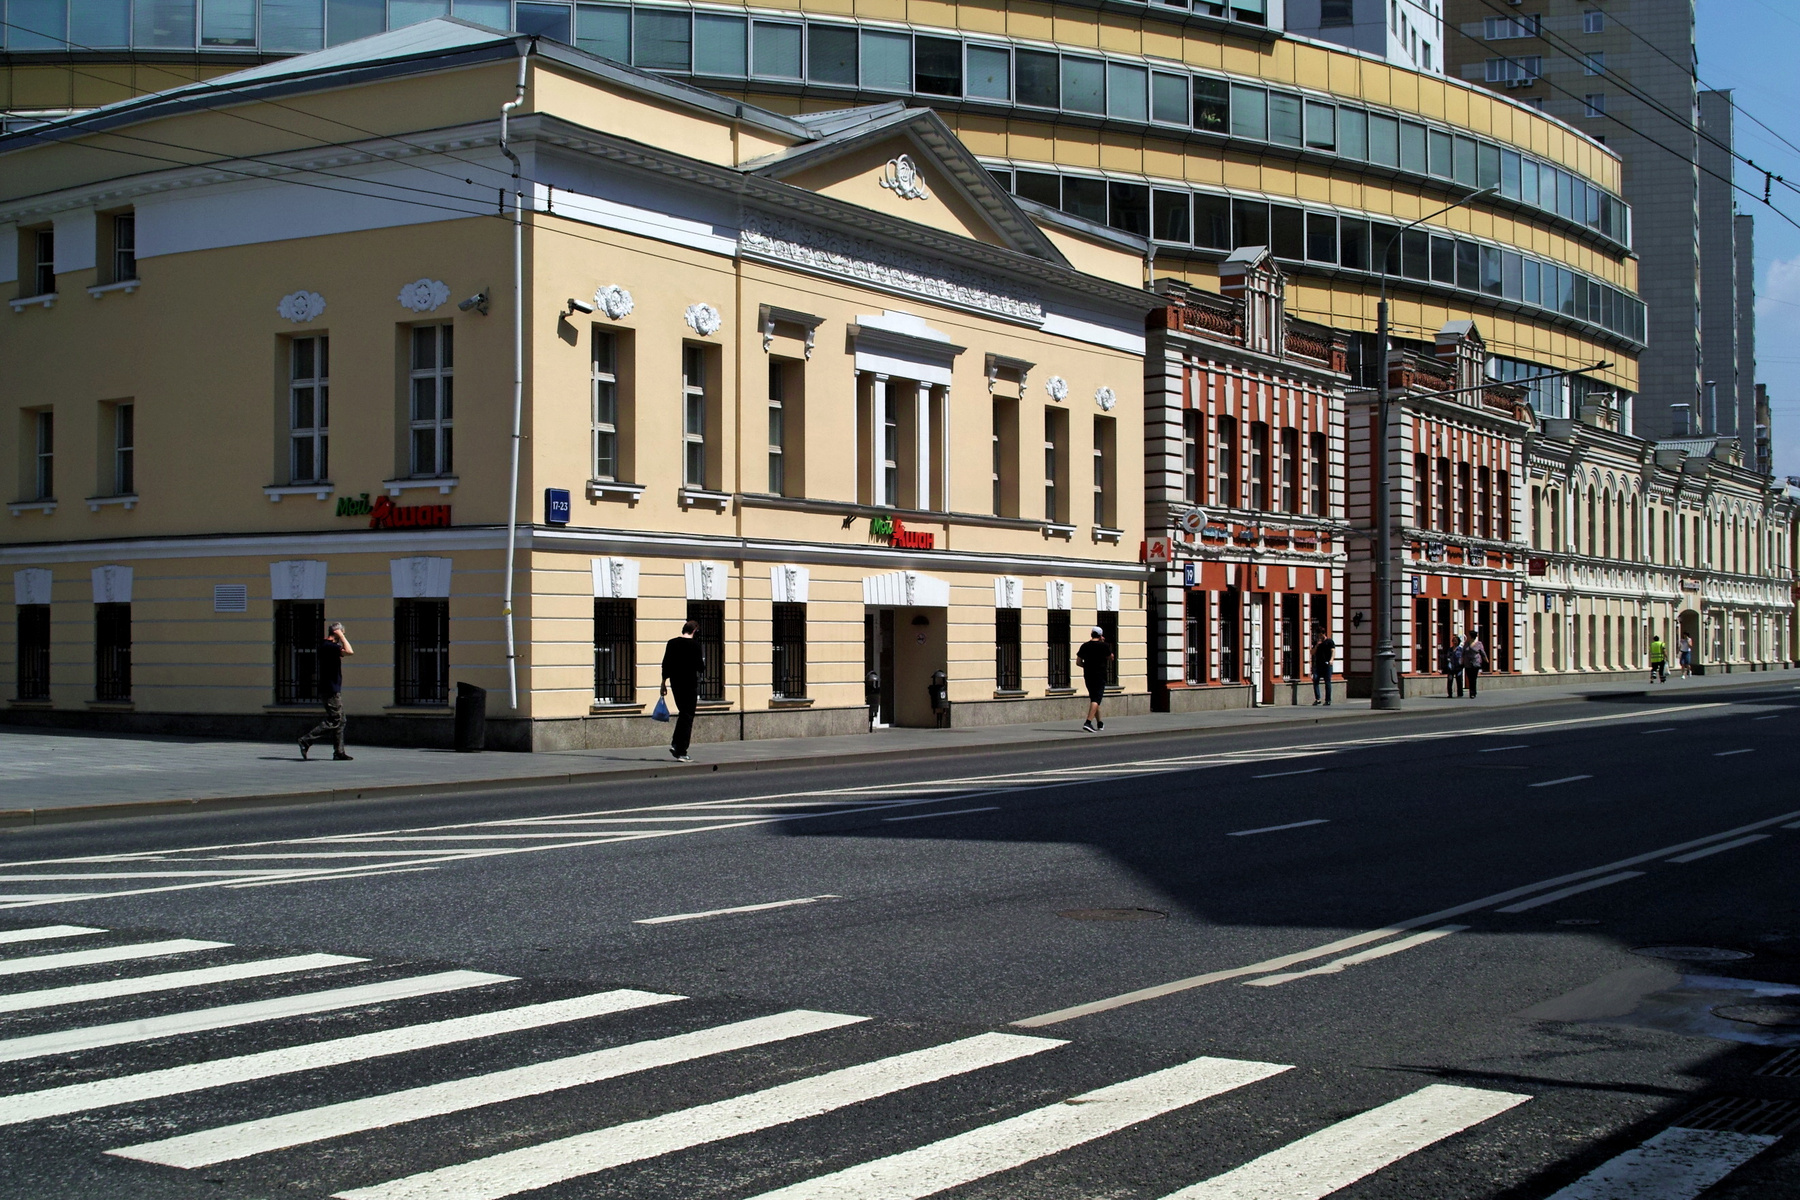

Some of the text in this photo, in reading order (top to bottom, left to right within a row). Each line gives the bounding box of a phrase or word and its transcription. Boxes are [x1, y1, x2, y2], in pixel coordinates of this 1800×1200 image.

[336, 493, 452, 527] Мой Ашан
[552, 501, 568, 511] 17-23
[873, 515, 935, 549] Мой Ашан
[1186, 569, 1194, 581] 19
